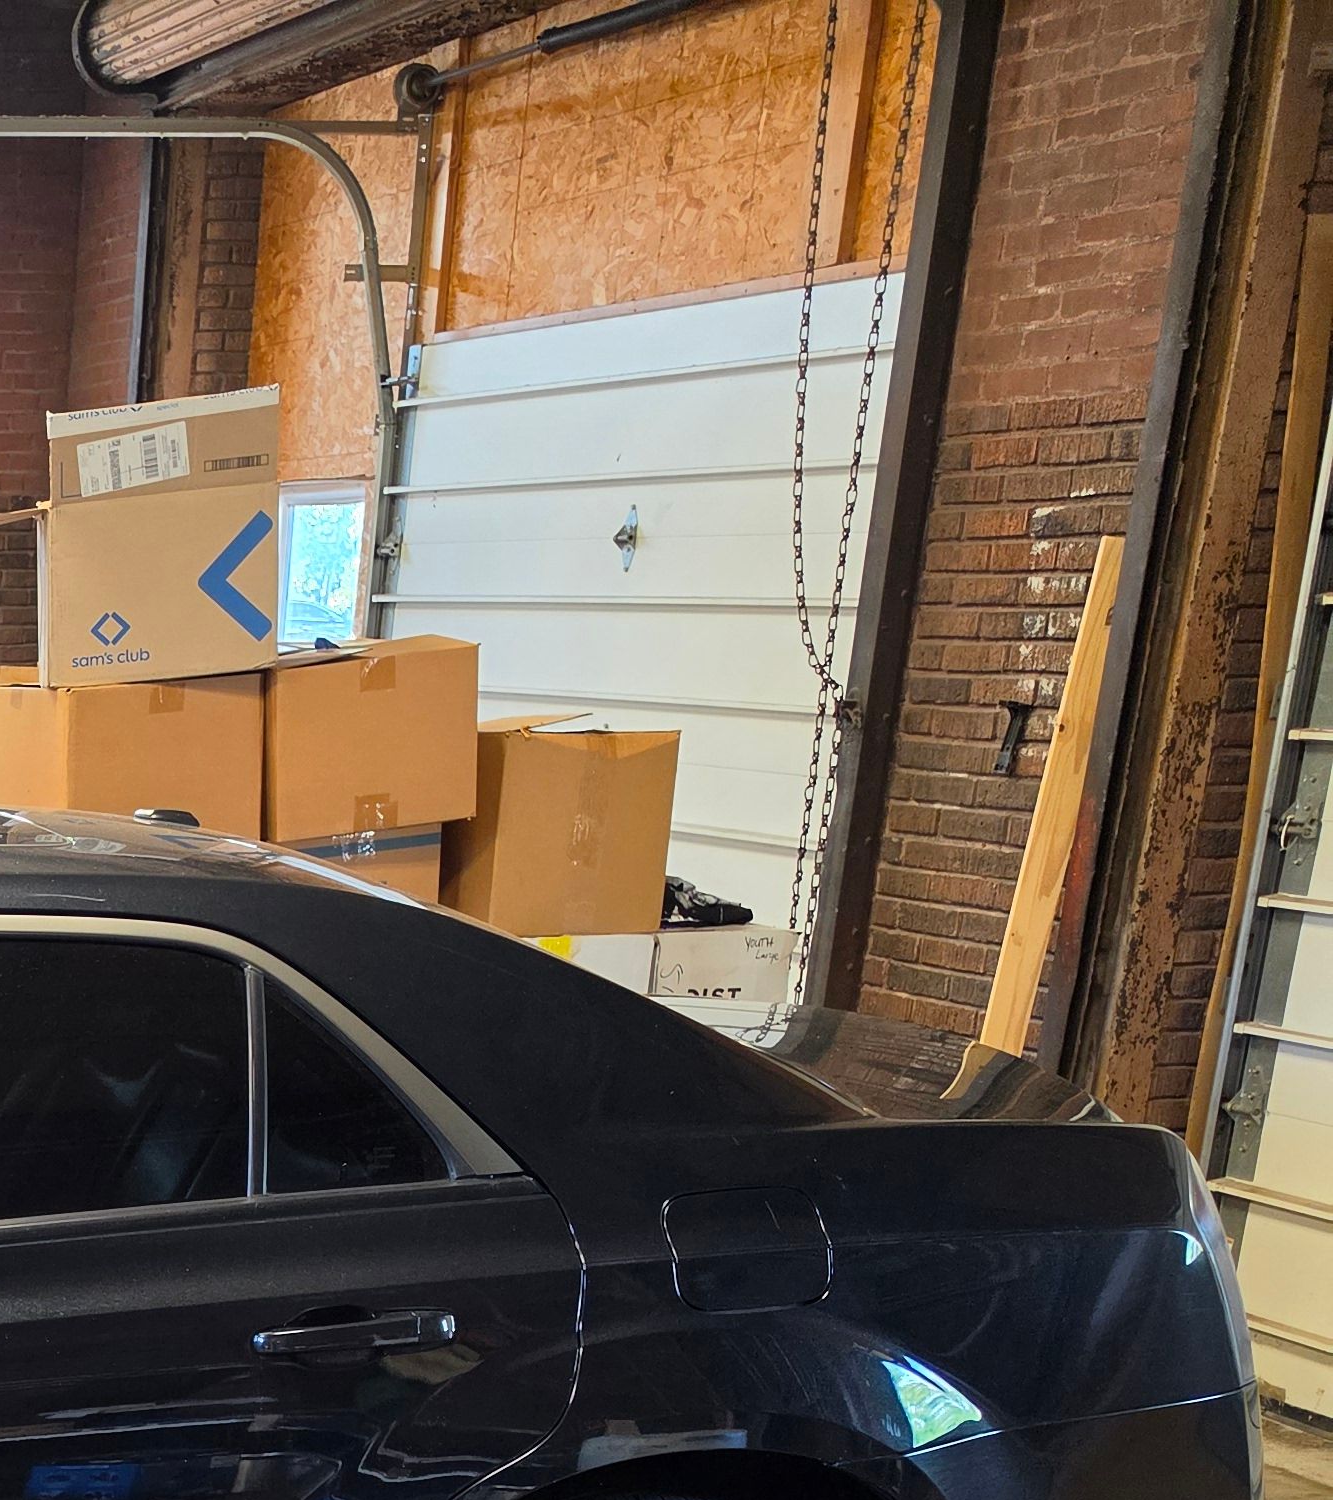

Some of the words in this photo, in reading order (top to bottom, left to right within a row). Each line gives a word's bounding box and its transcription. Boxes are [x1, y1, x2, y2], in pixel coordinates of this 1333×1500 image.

[72, 652, 113, 668] sam's
[117, 648, 150, 663] club
[744, 935, 774, 951] YOUTH
